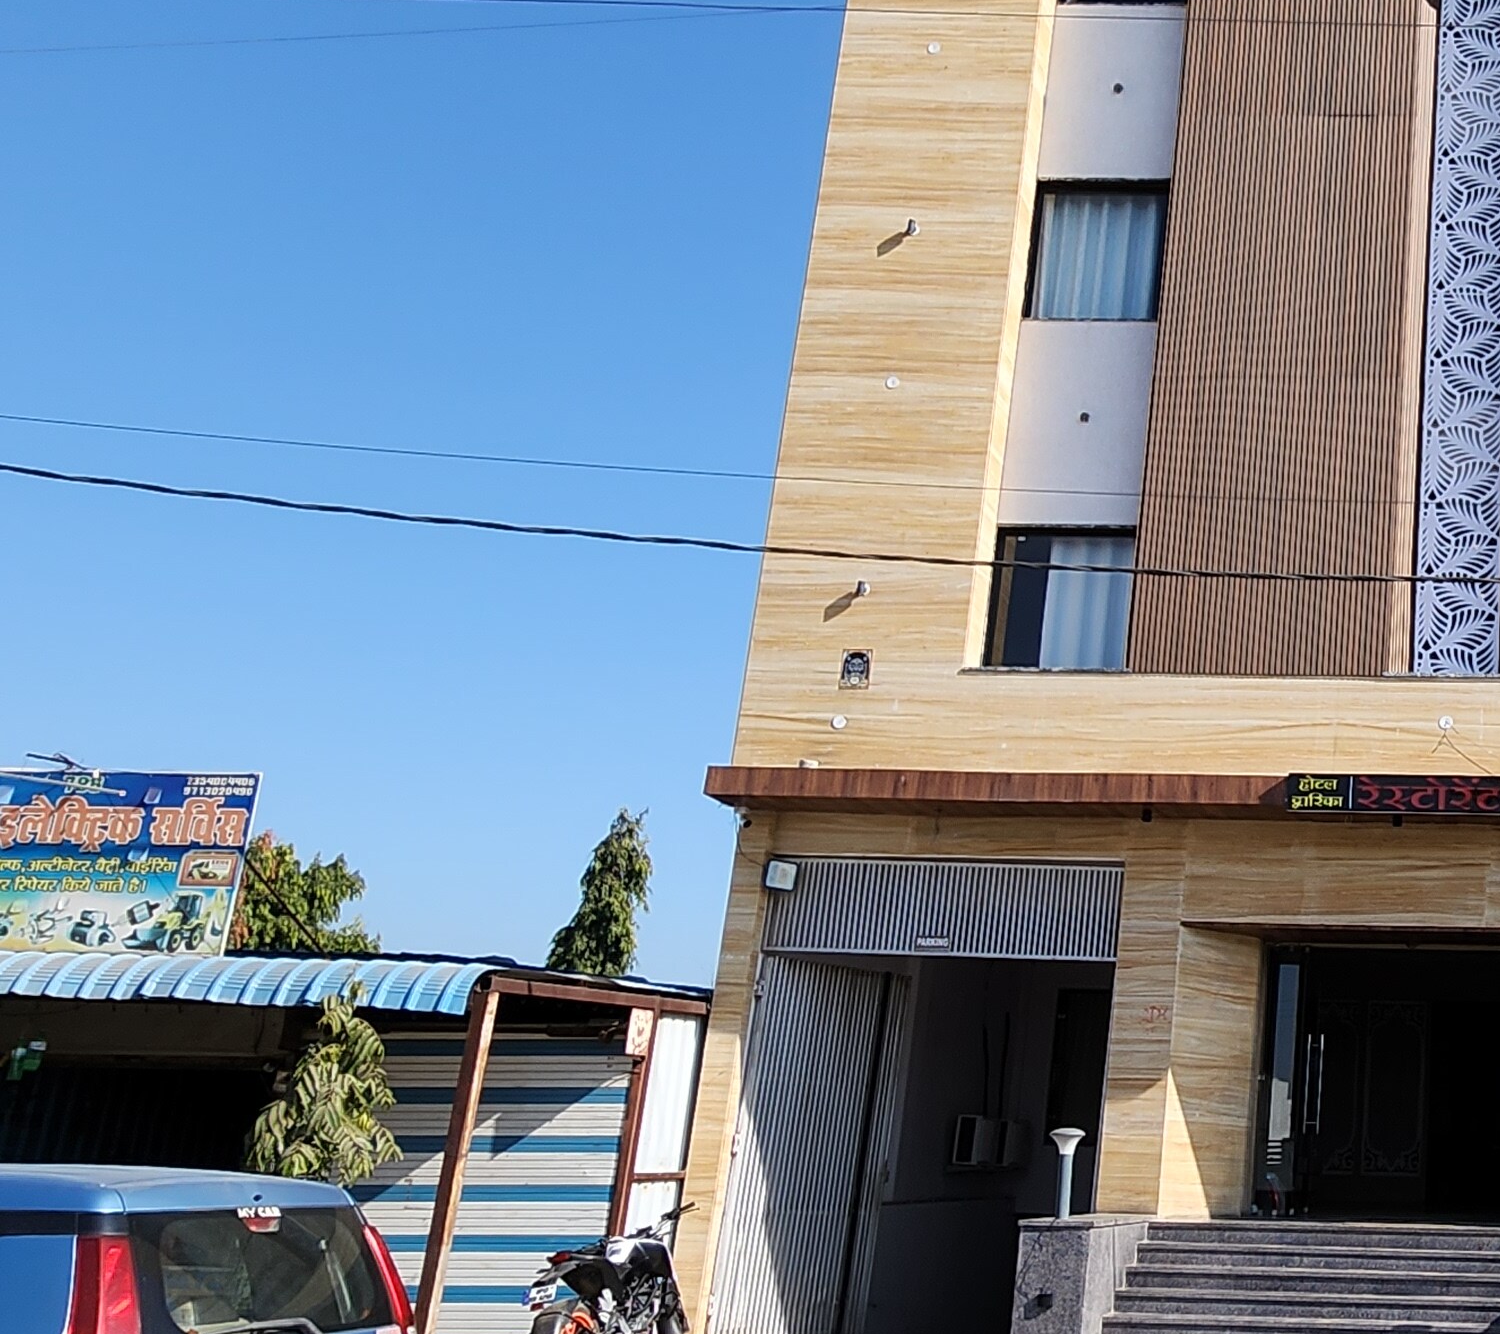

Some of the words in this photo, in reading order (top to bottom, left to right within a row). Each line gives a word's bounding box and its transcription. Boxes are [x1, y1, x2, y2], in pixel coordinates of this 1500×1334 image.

[1298, 775, 1337, 791] होटल
[1357, 775, 1500, 811] रेस्टोरेंट
[150, 797, 249, 847] सर्विस
[916, 937, 949, 947] PARKING
